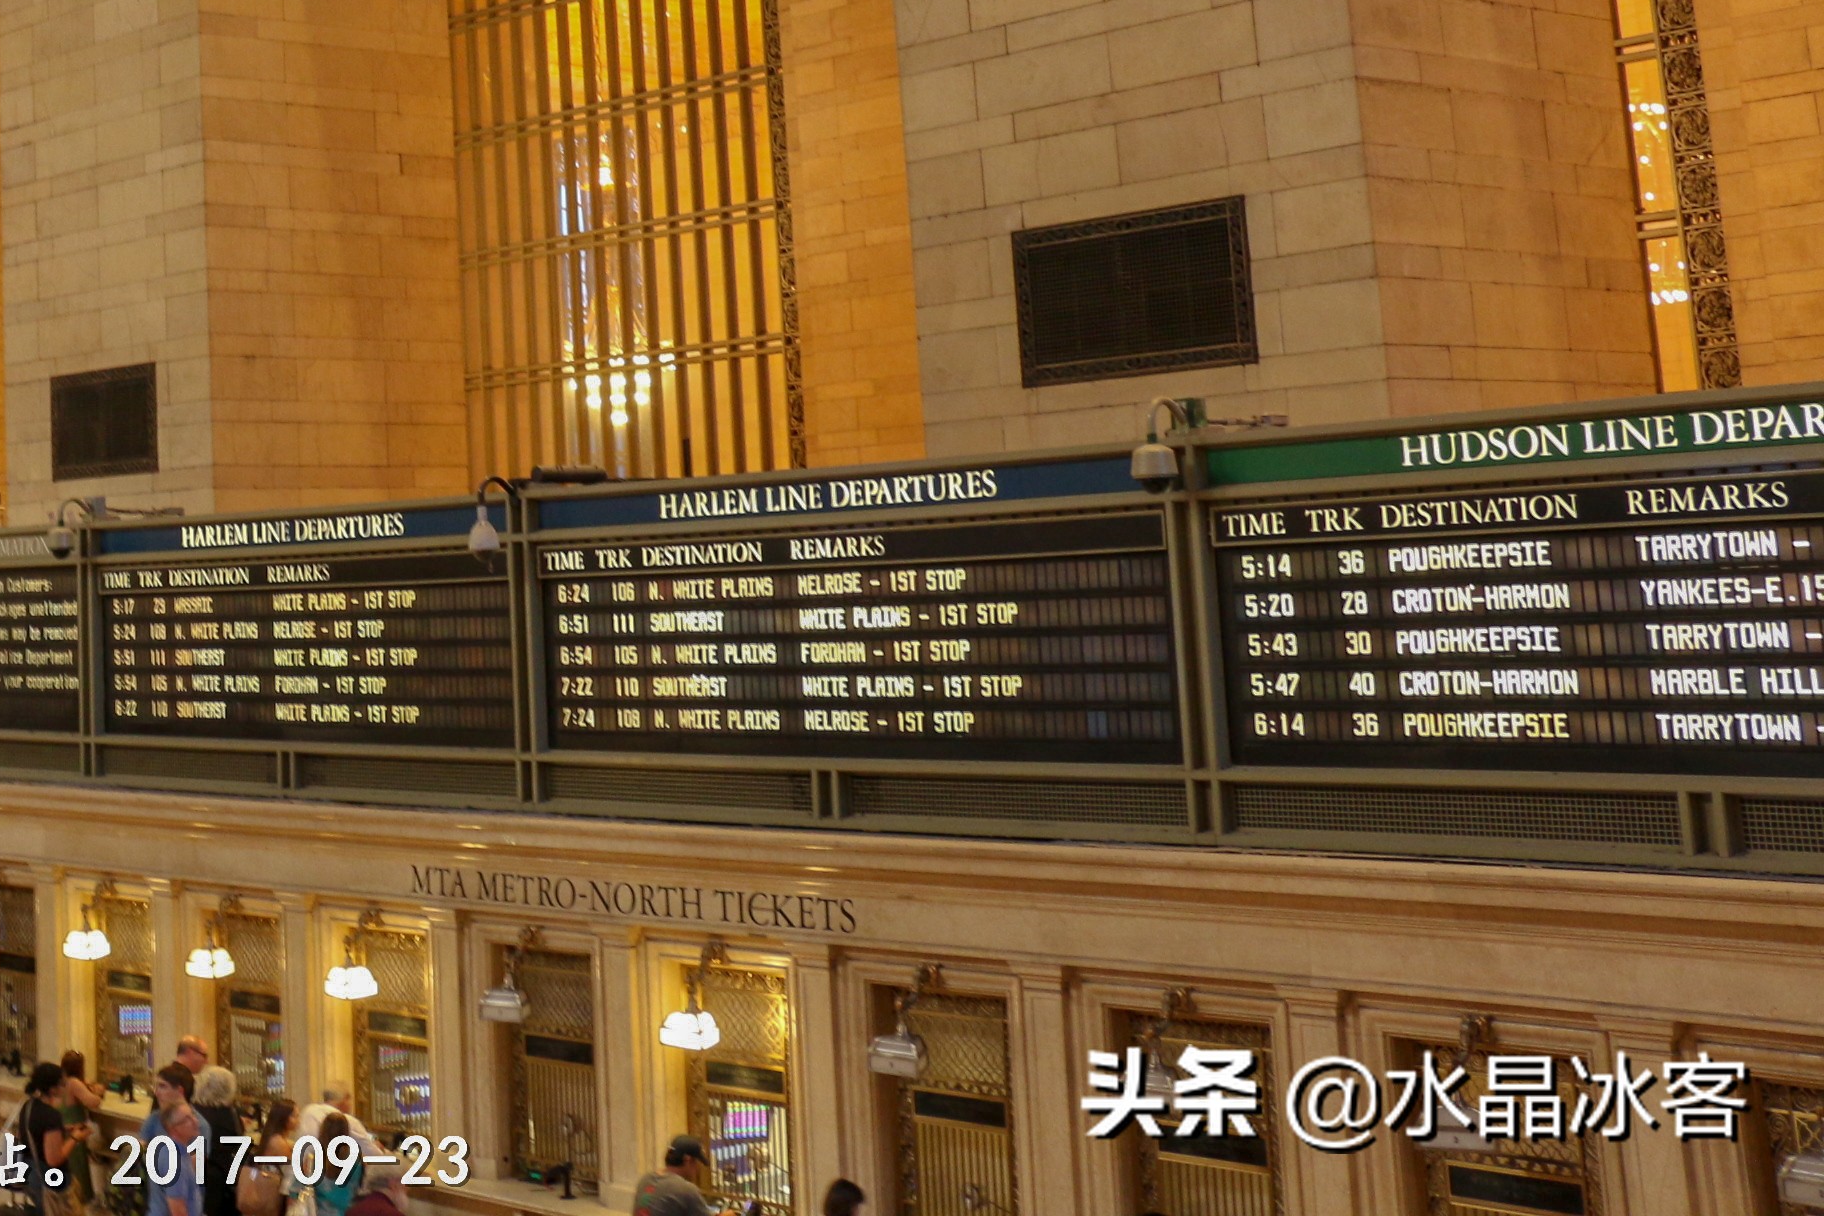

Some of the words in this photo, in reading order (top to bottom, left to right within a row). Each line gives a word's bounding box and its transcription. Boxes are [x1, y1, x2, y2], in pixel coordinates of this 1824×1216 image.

[1401, 424, 1570, 466] HUDSON
[1580, 415, 1678, 453] LINE
[659, 489, 758, 519] HARLEM
[765, 483, 823, 512] LINE
[830, 469, 998, 508] DEPARTURES
[1223, 512, 1286, 537] TIME
[1305, 507, 1364, 532] TRK
[1380, 494, 1578, 528] DESTINATION
[1626, 481, 1789, 515] REMARKS
[181, 523, 248, 548] HARLEM
[251, 520, 291, 544] LINE
[294, 512, 405, 542] DEPARTURES
[544, 551, 585, 571] TIME
[595, 548, 632, 569] TRK
[642, 541, 762, 567] DESTINATION
[790, 535, 886, 560] REMARKS
[1241, 554, 1292, 578] 5:14
[1338, 550, 1364, 574] 36
[1388, 540, 1552, 572] POUGHKEEPSIE
[1635, 529, 1778, 562] TARRYTOWN
[105, 572, 131, 589] TIME
[137, 570, 163, 587] TRK
[169, 566, 250, 586] DESTINATION
[267, 564, 331, 582] REMARKS
[557, 583, 590, 603] 6:24
[612, 582, 635, 602] 106
[648, 580, 664, 600] N.
[673, 579, 715, 599] WHITE
[721, 576, 773, 598] PLAINS
[890, 570, 917, 592] 1ST
[926, 568, 966, 591] STOP
[273, 593, 303, 612] WHITE
[308, 592, 346, 611] PLAINS
[364, 591, 384, 609] 1ST
[388, 590, 416, 609] STOP
[1245, 593, 1294, 617] 5:20
[1341, 591, 1368, 615] 28
[1392, 583, 1570, 614] CROTON-HARMON
[191, 622, 219, 640] WHITE
[223, 621, 258, 639] PLAINS
[334, 620, 352, 638] 1ST
[357, 620, 385, 638] STOP
[558, 614, 589, 634] 6:51
[613, 613, 634, 633] 111
[650, 610, 724, 632] SOUTHEAST
[799, 608, 846, 630] WHITE
[853, 606, 910, 628] PLAINS
[939, 604, 968, 626] 1ST
[977, 602, 1018, 625] STOP
[559, 645, 592, 665] 6:54
[614, 645, 638, 665] 105
[651, 644, 667, 665] N.
[675, 644, 718, 664] WHITE
[724, 643, 777, 664] PLAINS
[893, 640, 921, 662] 1ST
[930, 639, 971, 661] STOP
[1248, 633, 1298, 656] 5:43
[1345, 631, 1371, 654] 30
[1396, 626, 1561, 654] POUGHKEEPSIE
[1645, 622, 1791, 650] TARRYTOWN
[175, 649, 225, 666] SOUTHEAST
[274, 648, 305, 667] WHITE
[310, 648, 348, 667] PLAINS
[366, 648, 385, 666] 1ST
[390, 647, 418, 666] STOP
[191, 675, 221, 692] WHITE
[224, 675, 260, 693] PLAINS
[336, 676, 354, 694] 1ST
[359, 676, 387, 694] STOP
[561, 677, 593, 696] 7:22
[616, 677, 639, 697] 110
[653, 676, 727, 697] SOUTHEAST
[802, 676, 849, 697] WHITE
[856, 676, 914, 697] PLAINS
[943, 676, 972, 697] 1ST
[980, 675, 1023, 697] STOP
[1250, 673, 1299, 696] 5:47
[1349, 672, 1376, 696] 40
[1399, 669, 1579, 696] CROTON-HARMON
[1650, 668, 1747, 695] MARBLE
[1760, 668, 1824, 694] HILL
[176, 701, 226, 719] SOUTHEAST
[276, 703, 307, 722] WHITE
[311, 704, 349, 723] PLAINS
[368, 705, 387, 723] 1ST
[392, 705, 420, 724] STOP
[562, 708, 595, 728] 7:24
[654, 708, 670, 729] N.
[678, 709, 721, 729] WHITE
[727, 709, 780, 730] PLAINS
[897, 711, 925, 732] 1ST
[933, 712, 974, 734] STOP
[1253, 712, 1305, 736] 6:14
[1352, 713, 1379, 736] 36
[1403, 712, 1570, 738] POUGHKEEPSIE
[1655, 713, 1803, 741] TARRYTOWN
[411, 864, 468, 899] MTA
[477, 871, 704, 919] METRO-NORTH
[715, 889, 856, 934] TICKETS
